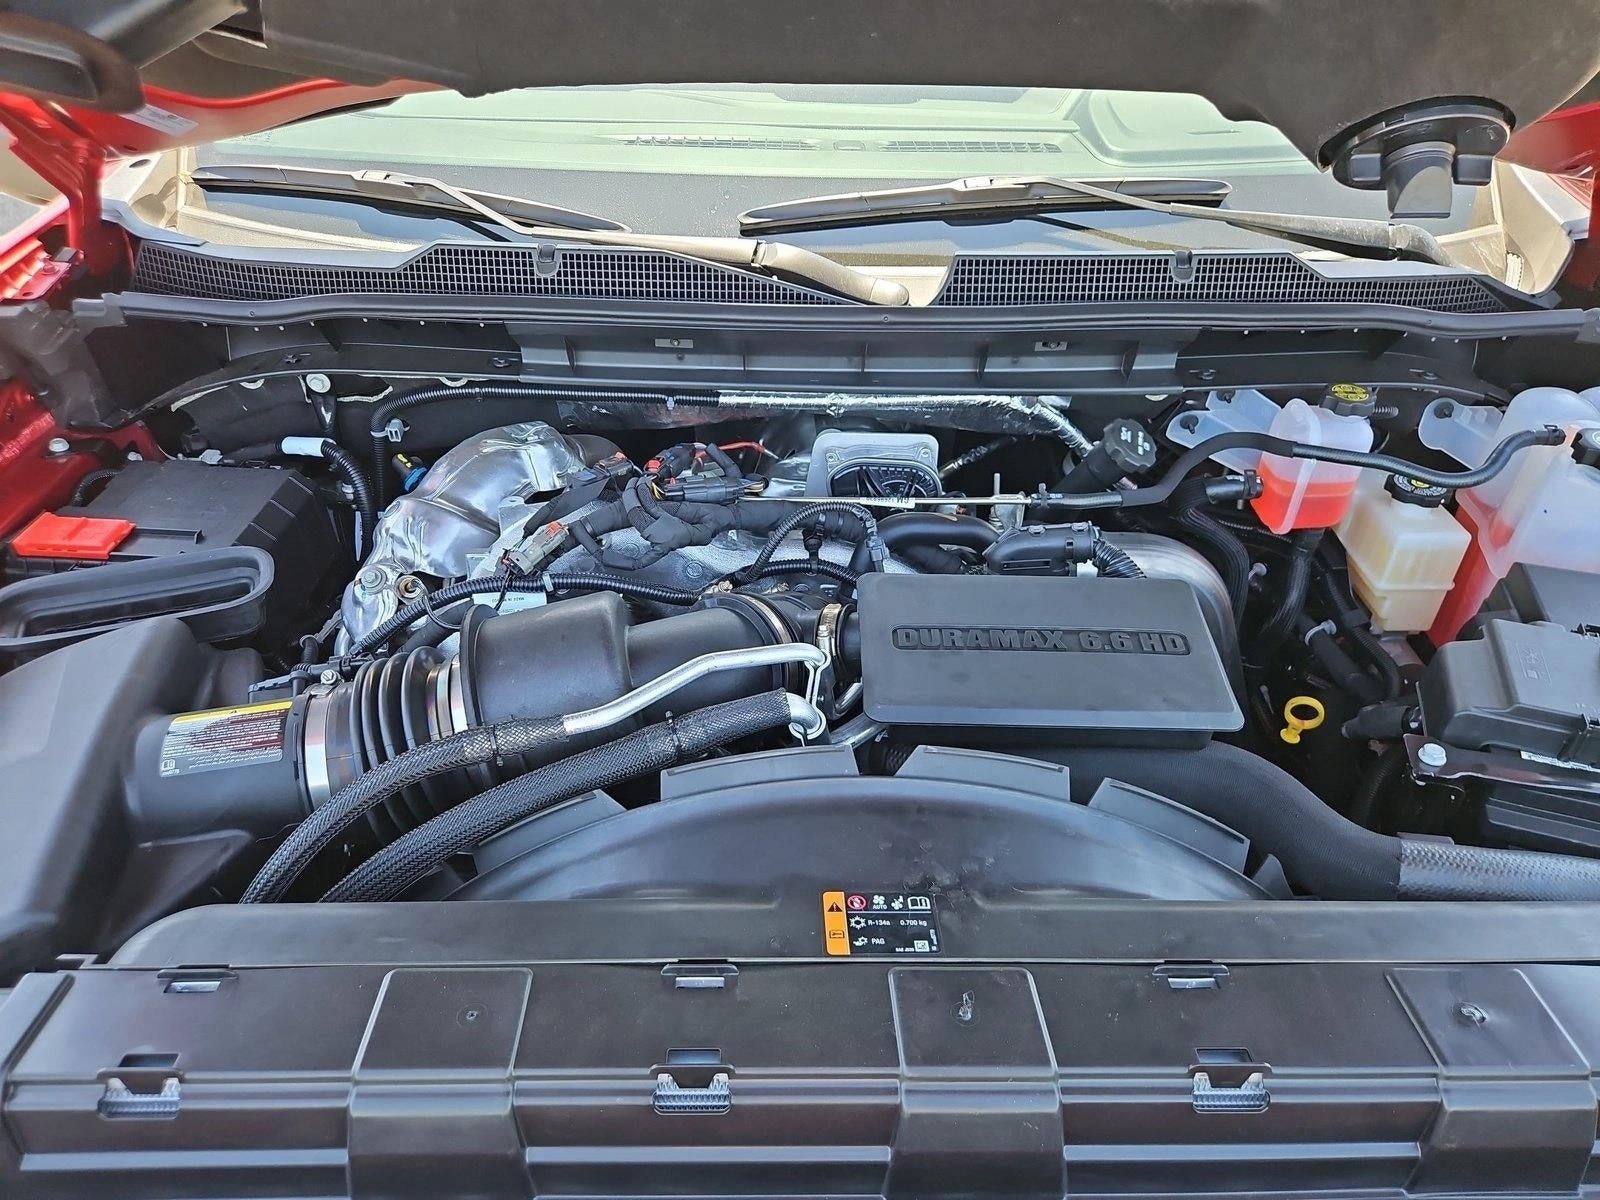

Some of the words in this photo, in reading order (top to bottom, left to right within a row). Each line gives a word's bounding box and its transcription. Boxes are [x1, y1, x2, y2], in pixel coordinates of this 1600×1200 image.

[896, 628, 1067, 650] DURAMAX
[1079, 631, 1131, 651] 6.6
[1140, 632, 1187, 653] HD
[918, 919, 928, 927] kg
